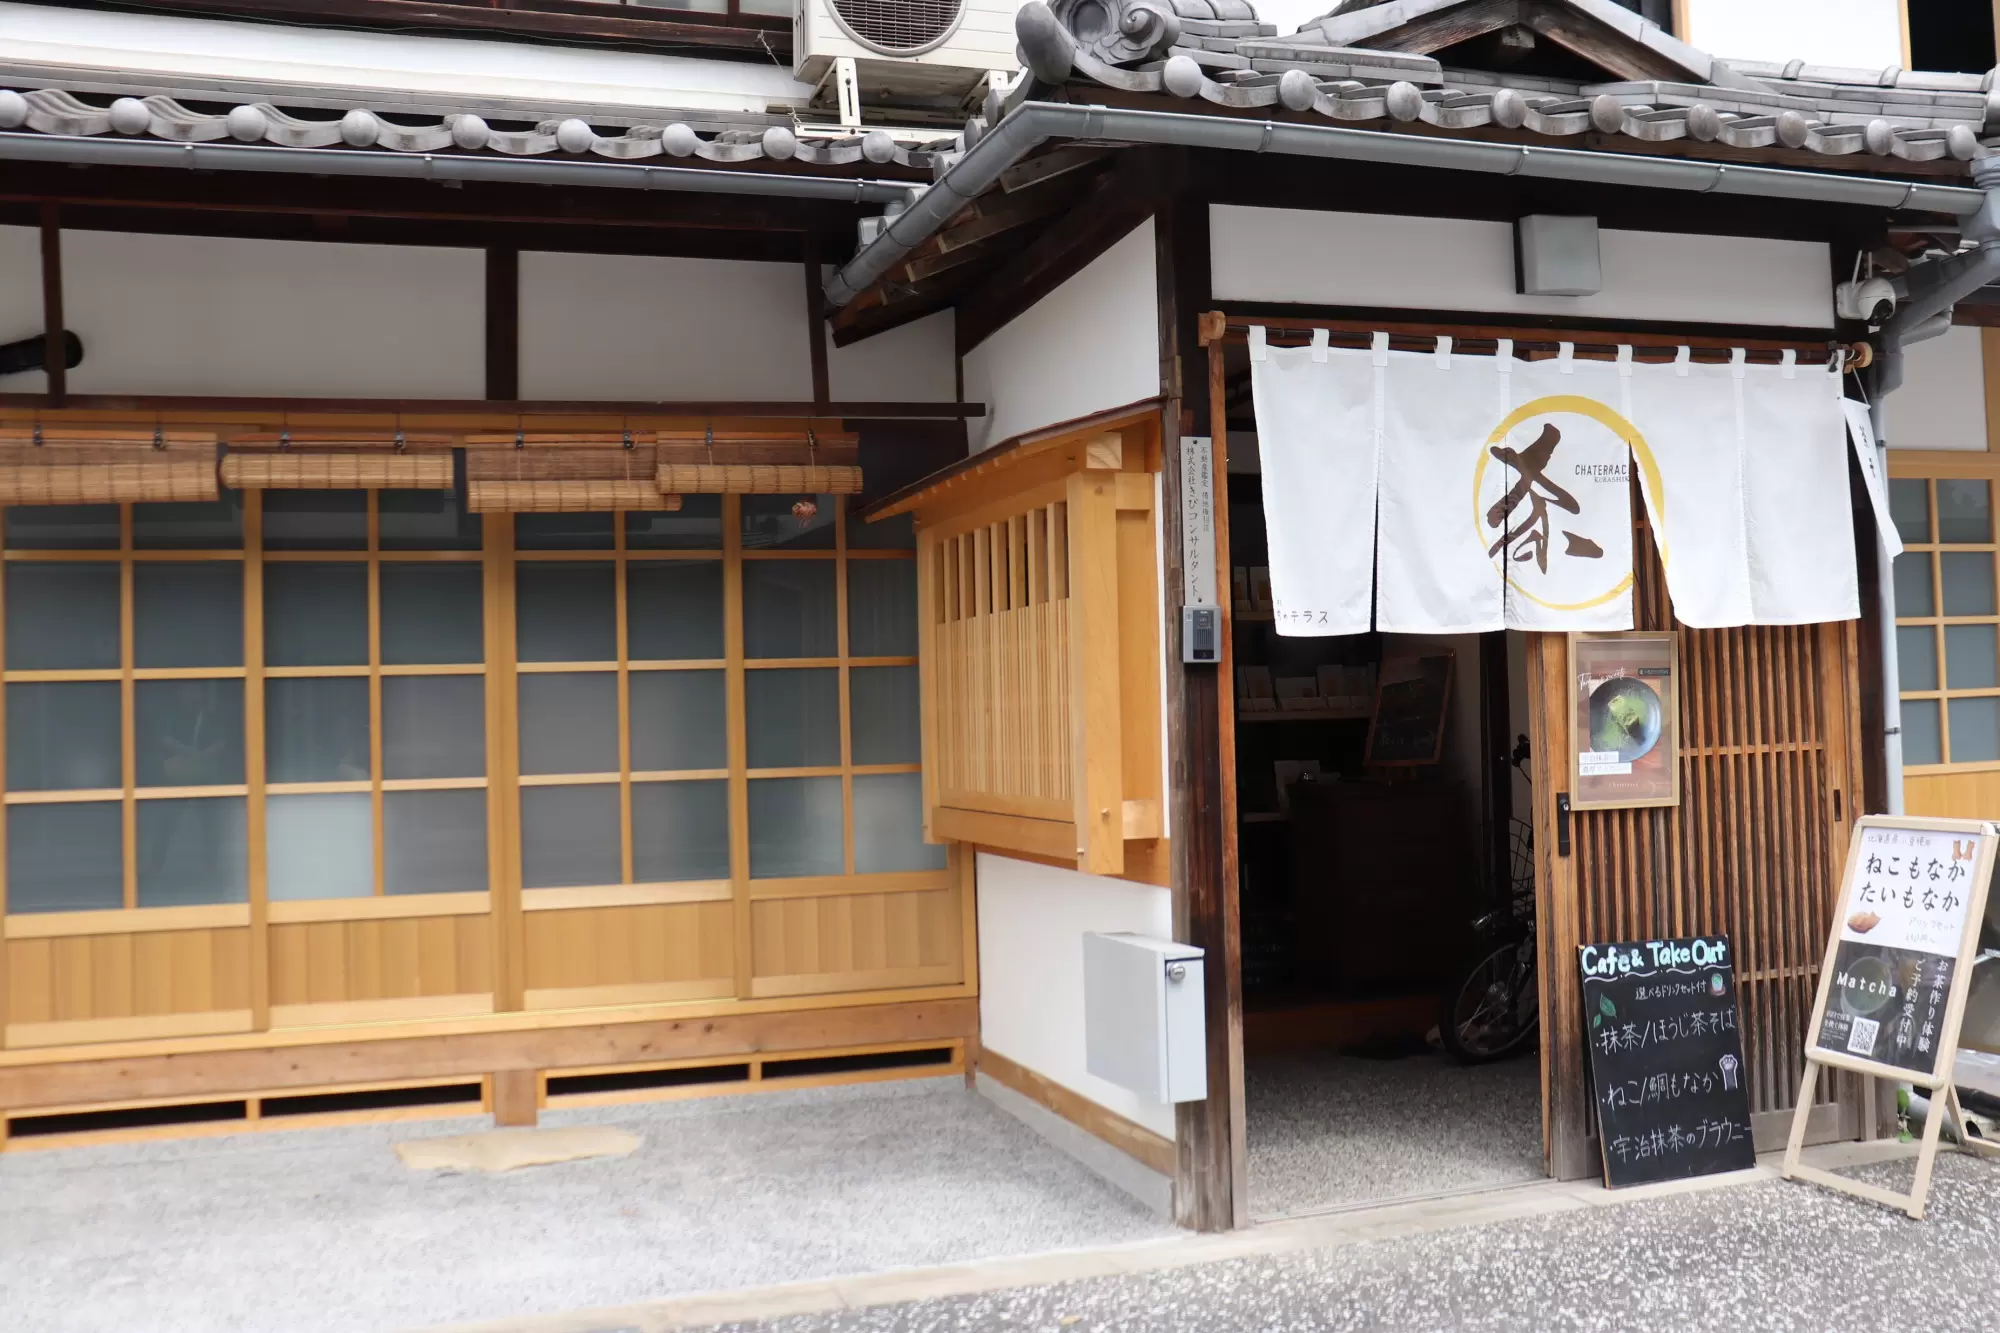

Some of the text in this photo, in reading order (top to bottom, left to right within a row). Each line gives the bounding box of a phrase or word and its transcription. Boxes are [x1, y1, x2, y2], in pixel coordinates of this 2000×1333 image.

[1575, 464, 1630, 476] CHATERRAC
[1186, 446, 1200, 597] 株式会社きびコンサルタント
[1866, 853, 1965, 882] ねこもなか
[1860, 881, 1959, 912] たいもなか
[1837, 971, 1897, 998] Matcha
[1896, 958, 1925, 1048] ご予約受付中
[1918, 960, 1948, 1053] お茶作り体験
